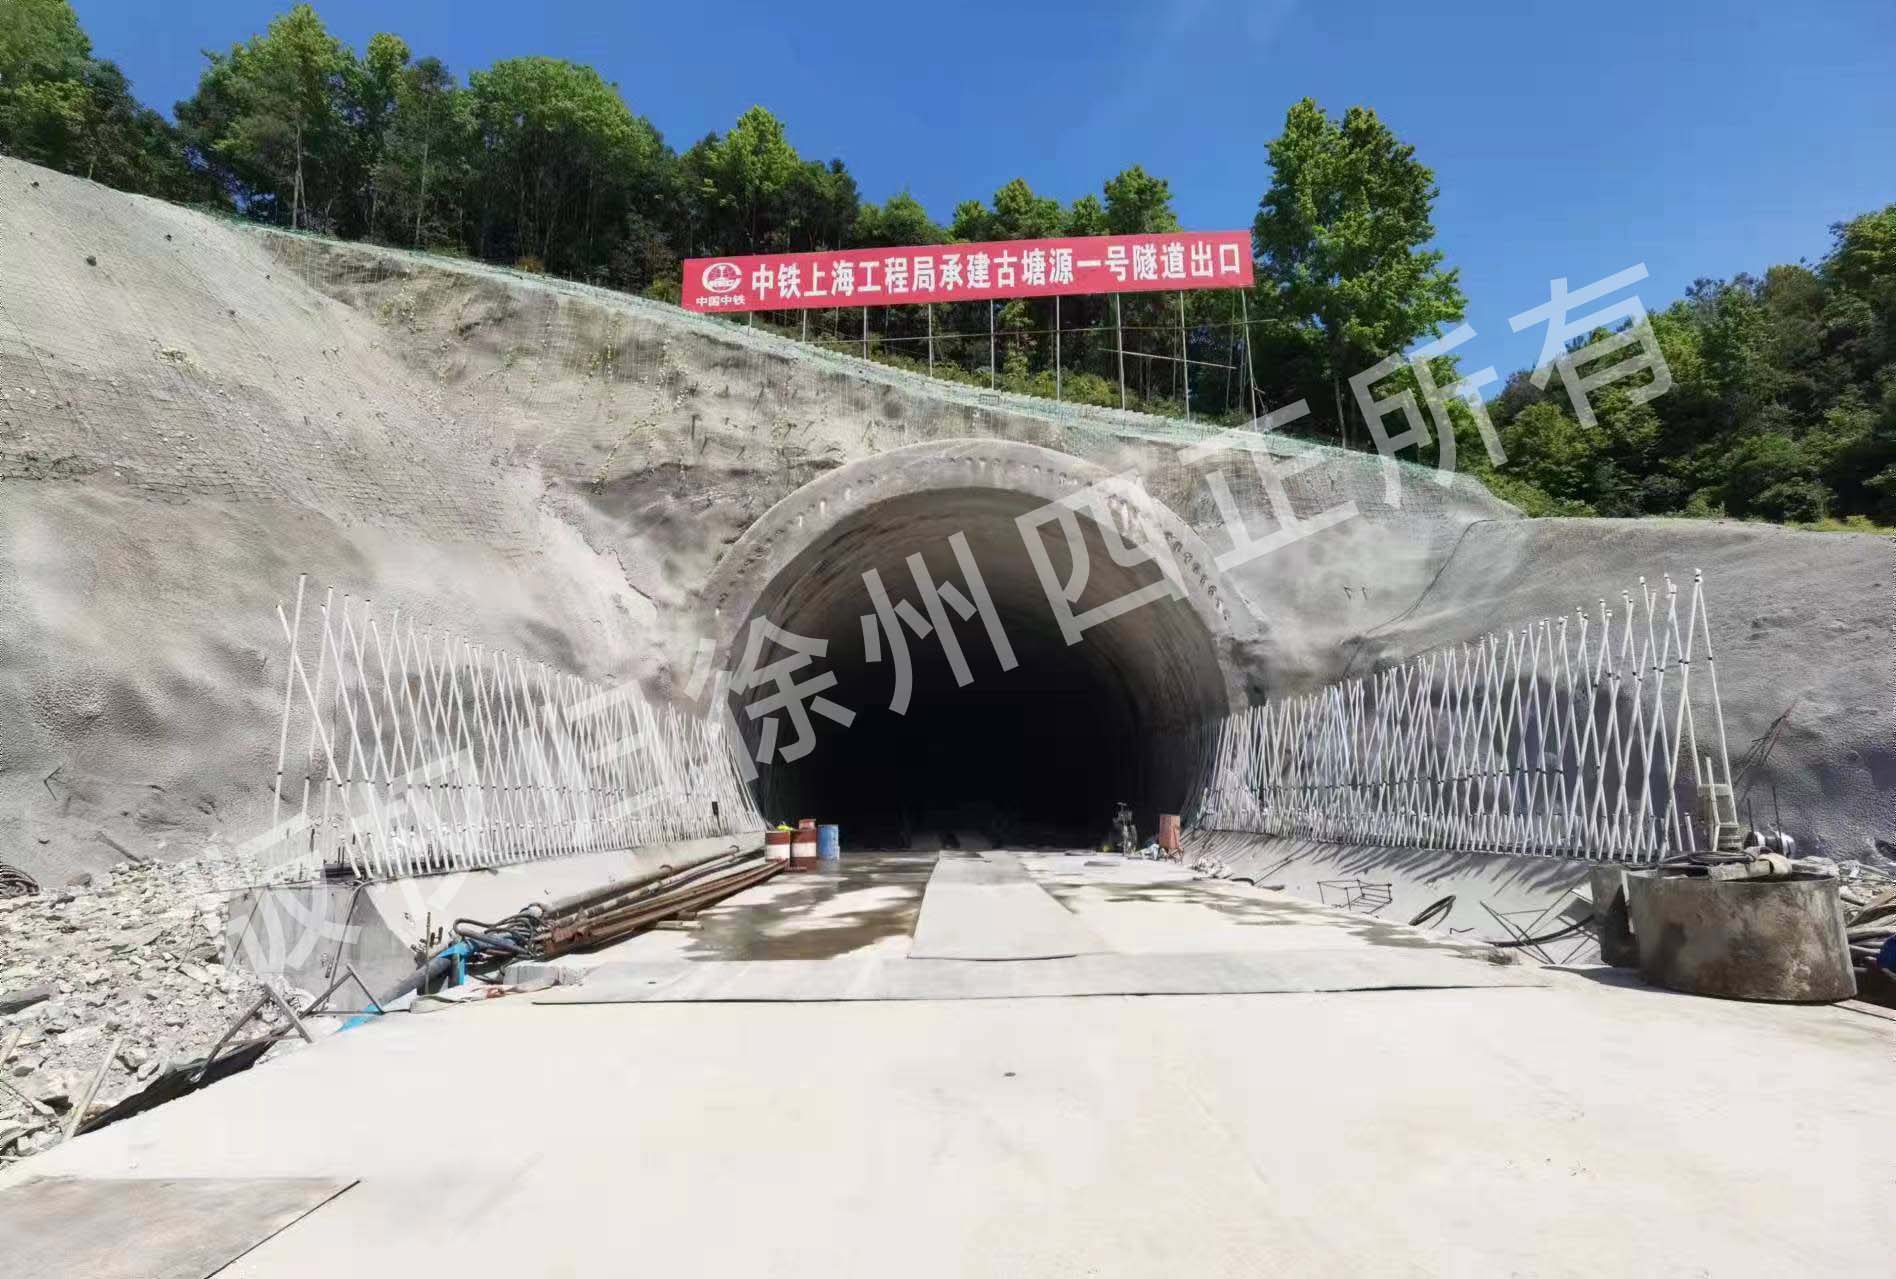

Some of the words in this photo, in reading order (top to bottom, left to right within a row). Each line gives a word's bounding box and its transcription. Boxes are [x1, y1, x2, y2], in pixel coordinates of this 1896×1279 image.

[751, 241, 1241, 300] 中铁上海工程局承建古塘源一号隧道出口
[695, 295, 746, 307] 中国中铁
